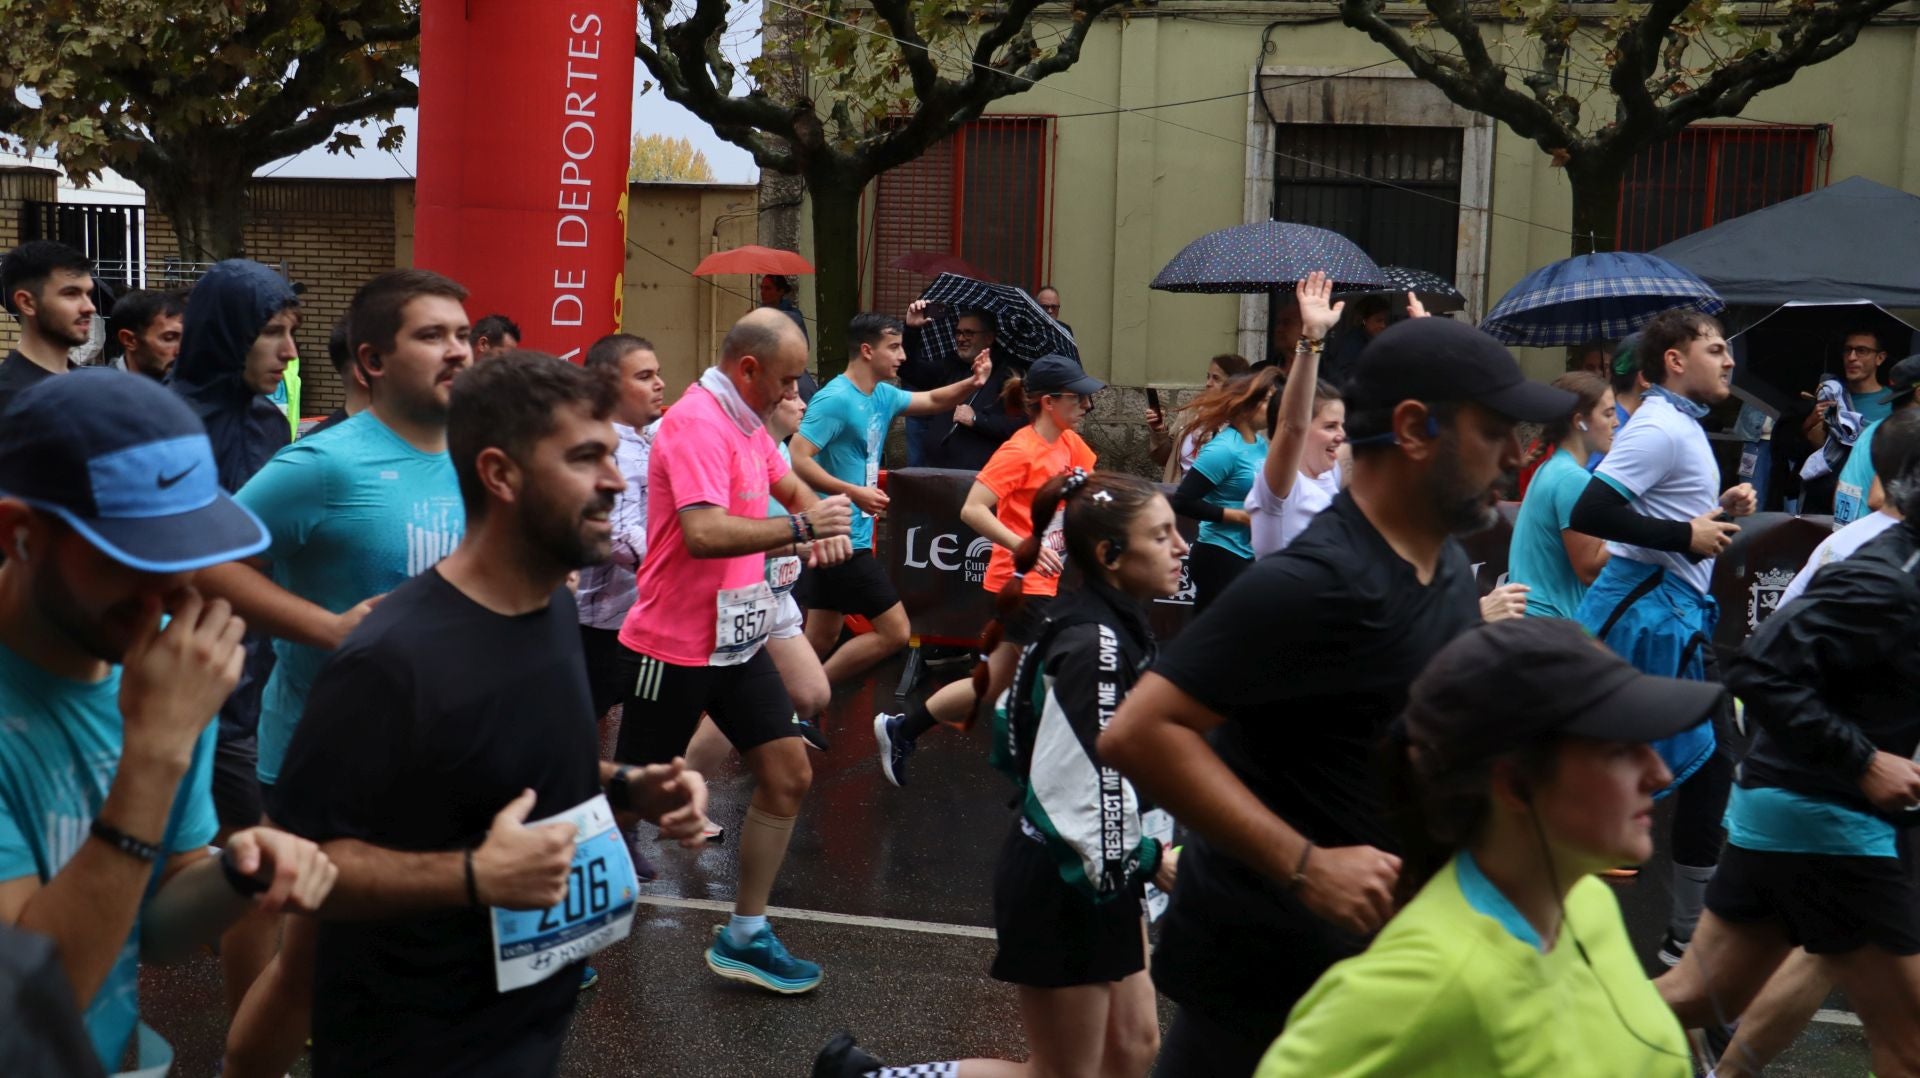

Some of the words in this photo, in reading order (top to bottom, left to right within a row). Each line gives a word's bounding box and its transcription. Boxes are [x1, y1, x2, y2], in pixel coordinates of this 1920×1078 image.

[556, 13, 602, 248] DEPORTES
[551, 269, 586, 327] DE
[734, 609, 767, 644] 857
[1098, 682, 1116, 706] ME
[1103, 793, 1122, 861] RESPECT
